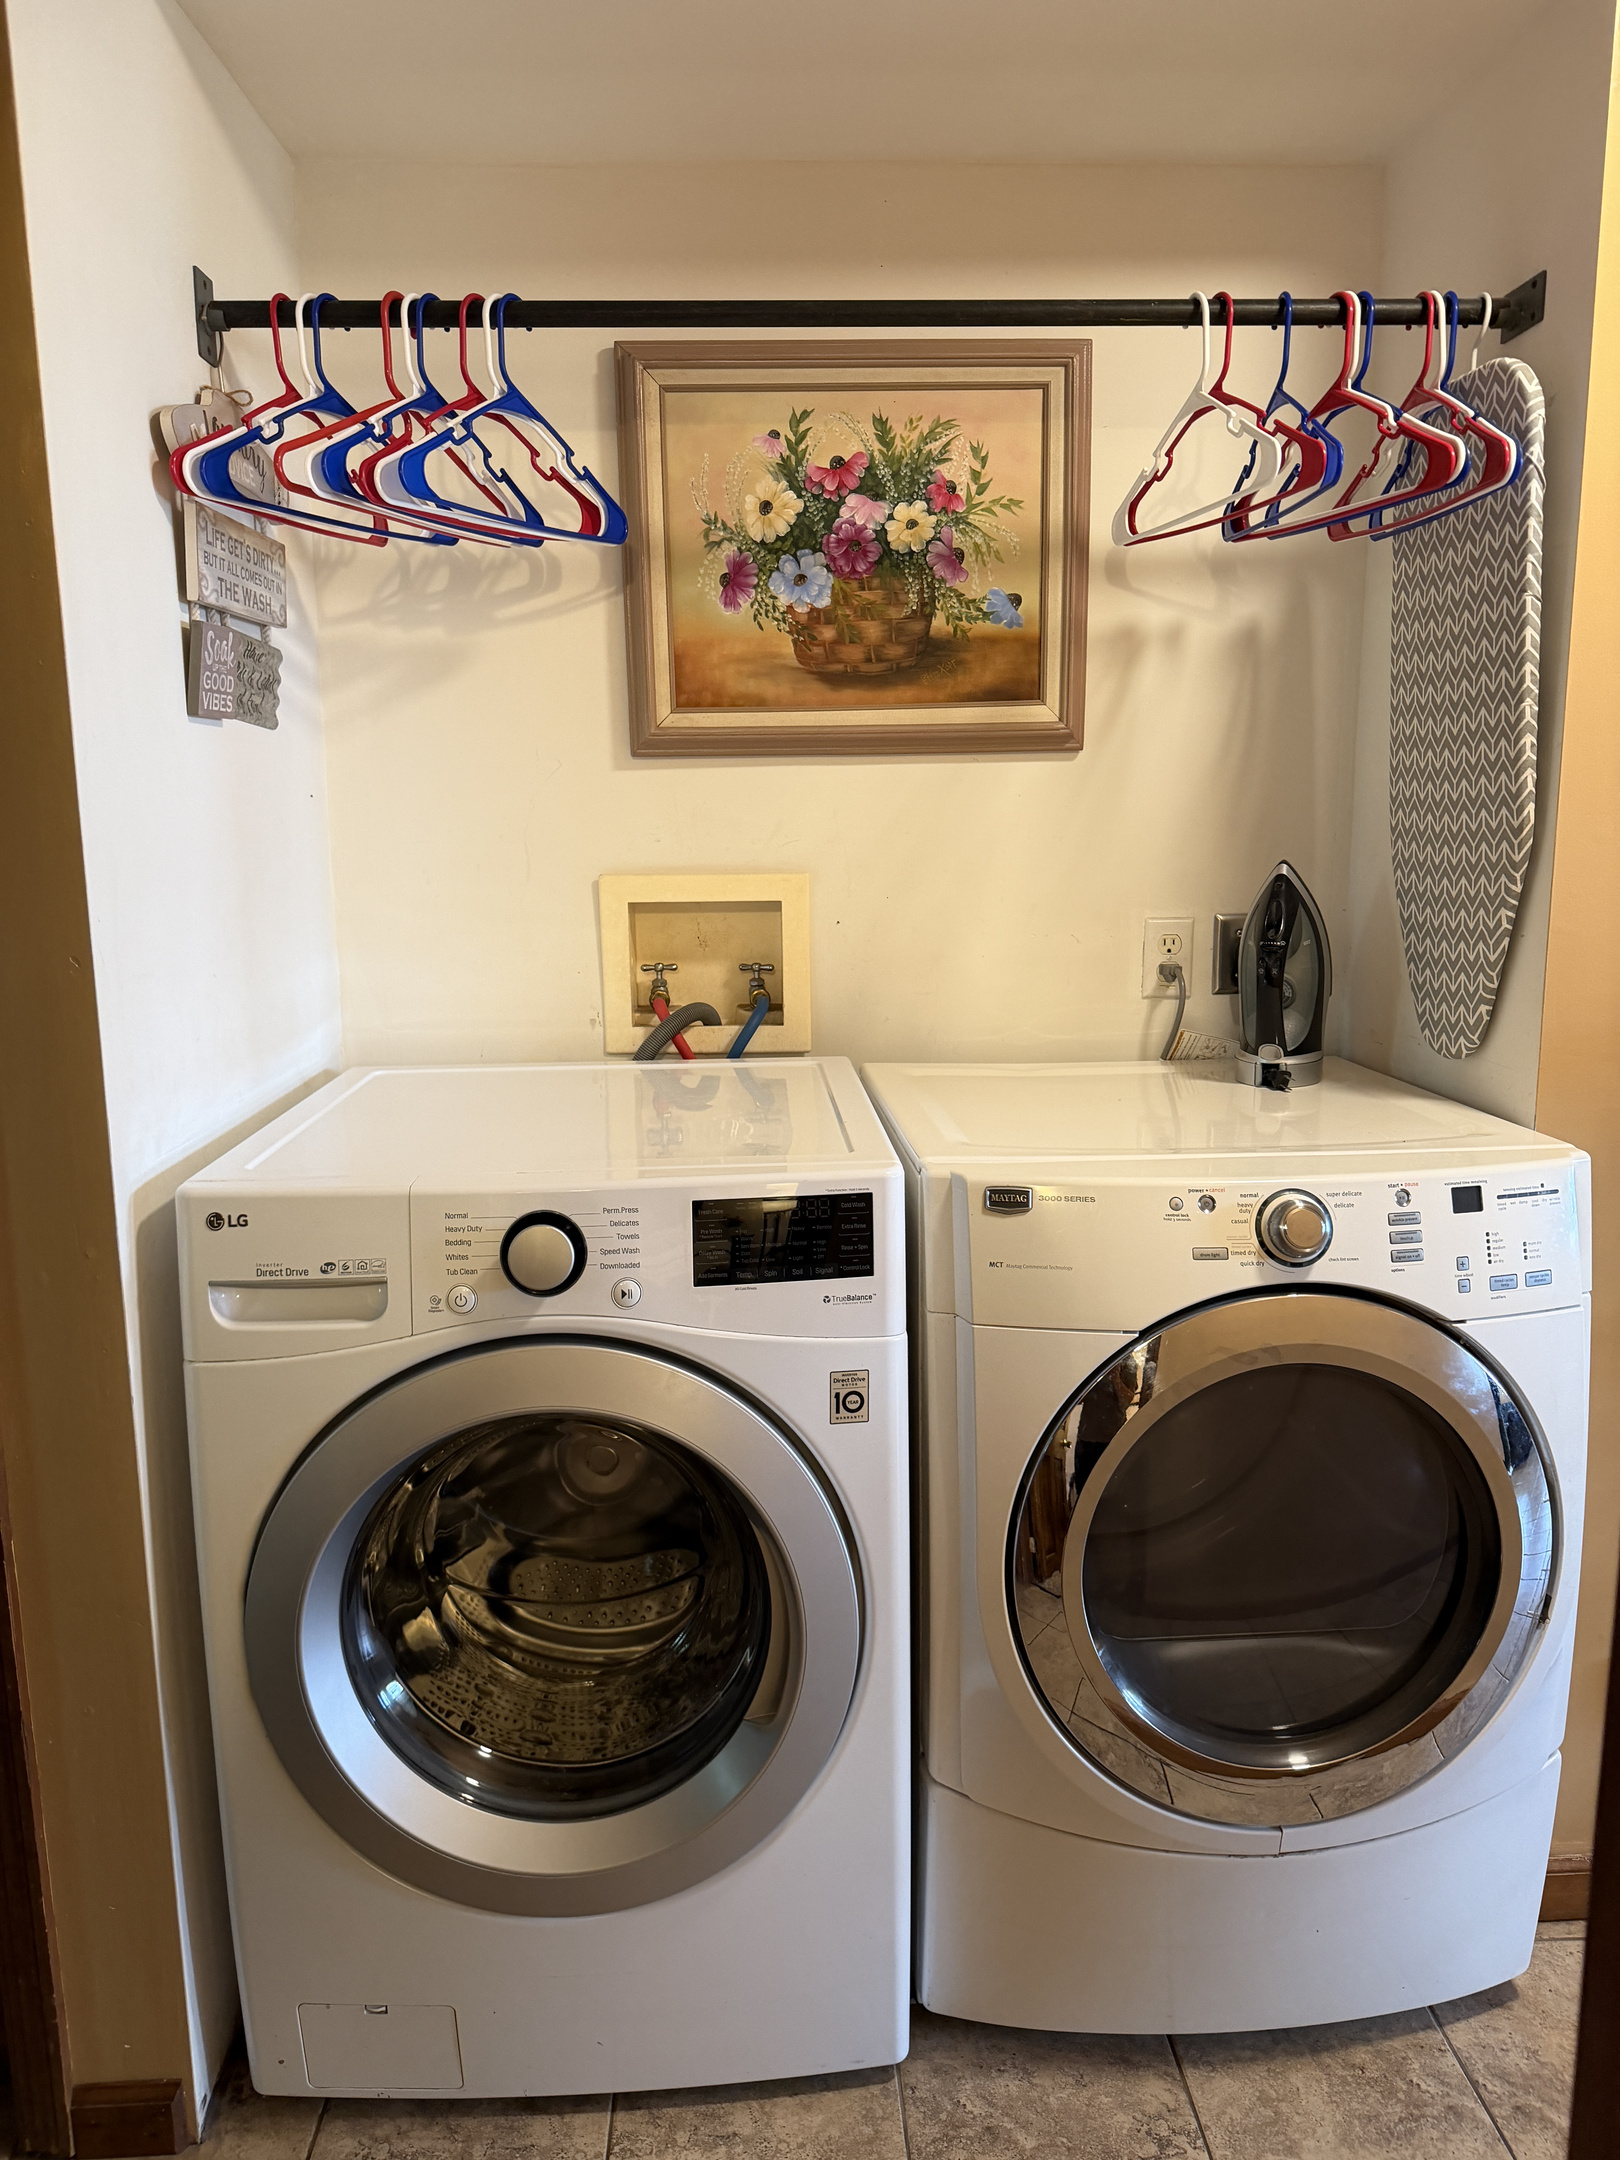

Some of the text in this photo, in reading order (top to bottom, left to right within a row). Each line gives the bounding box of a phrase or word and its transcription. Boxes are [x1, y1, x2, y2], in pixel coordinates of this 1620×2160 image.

[205, 520, 226, 552] LIFE
[228, 536, 251, 563] GET'S
[204, 550, 282, 595] BUT IT ALL COMES OUT IN
[218, 576, 272, 614] THE WASH
[205, 630, 236, 669] Soak
[203, 671, 234, 692] GOOD
[203, 691, 232, 712] VIBES
[991, 1194, 1027, 1202] MAYTAG
[228, 1214, 248, 1227] LG
[467, 1225, 482, 1233] Duty
[445, 1239, 472, 1247] Bedding
[600, 1248, 620, 1256] Speed
[256, 1268, 309, 1277] Direct Drive
[600, 1262, 640, 1270] Downloaded
[834, 1390, 864, 1414] 10
